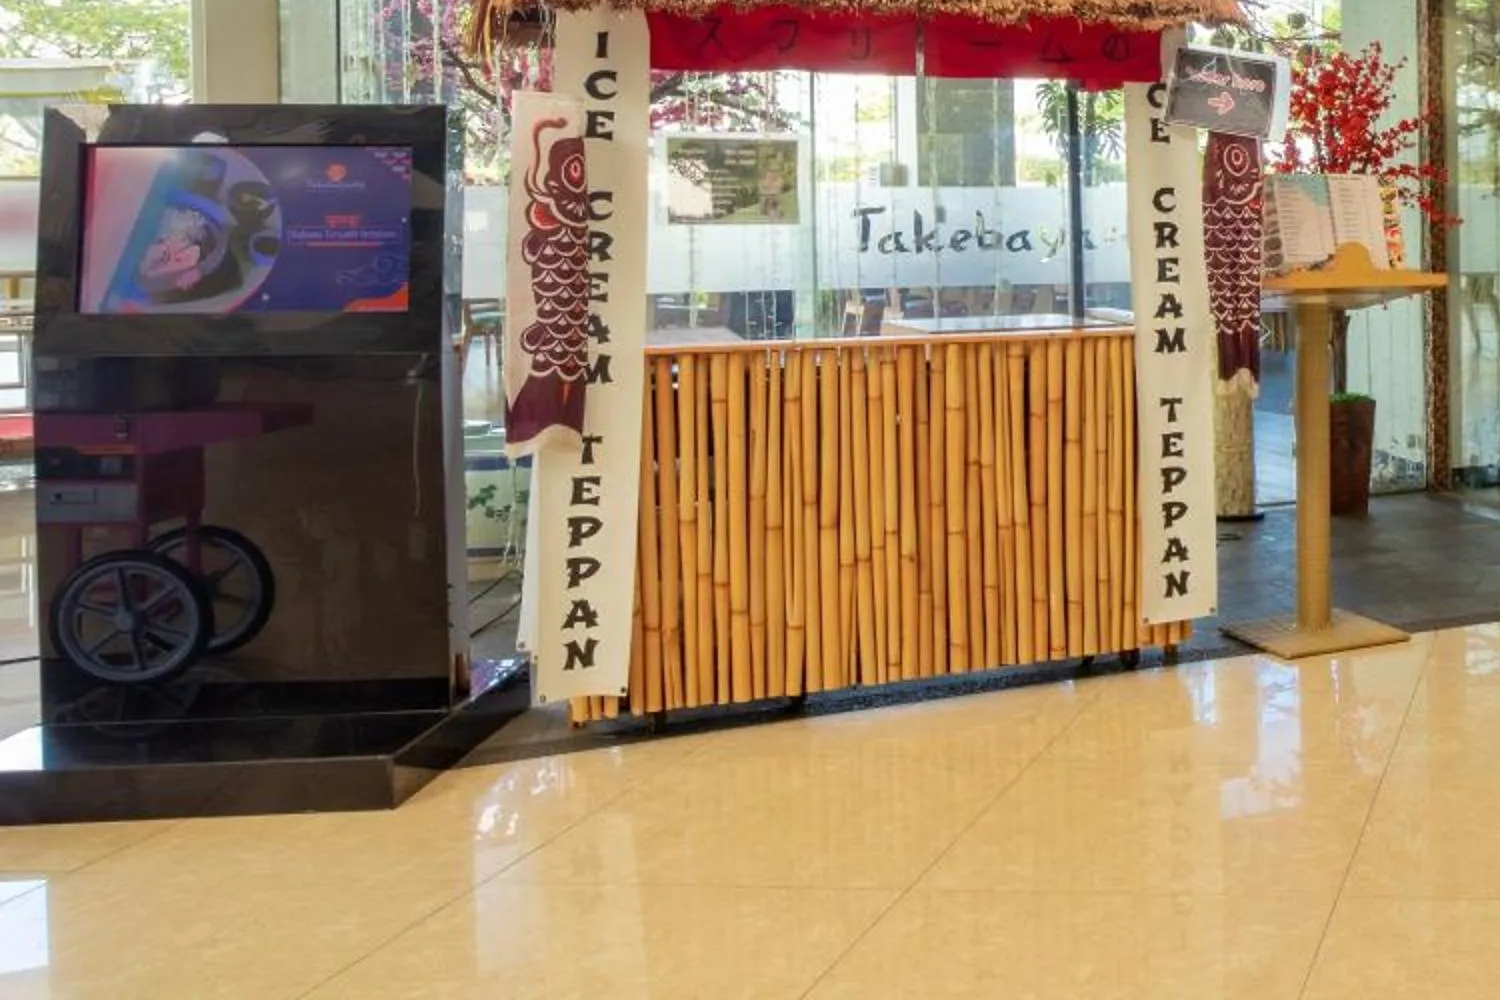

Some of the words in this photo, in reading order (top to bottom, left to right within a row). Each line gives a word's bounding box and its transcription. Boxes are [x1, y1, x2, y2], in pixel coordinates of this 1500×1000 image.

[584, 31, 617, 141] ICE
[1146, 83, 1171, 143] CE
[585, 191, 613, 384] CREAM
[1152, 187, 1187, 354] CREAM
[562, 434, 603, 671] TEPPAN
[1160, 397, 1191, 598] TEPPAN
